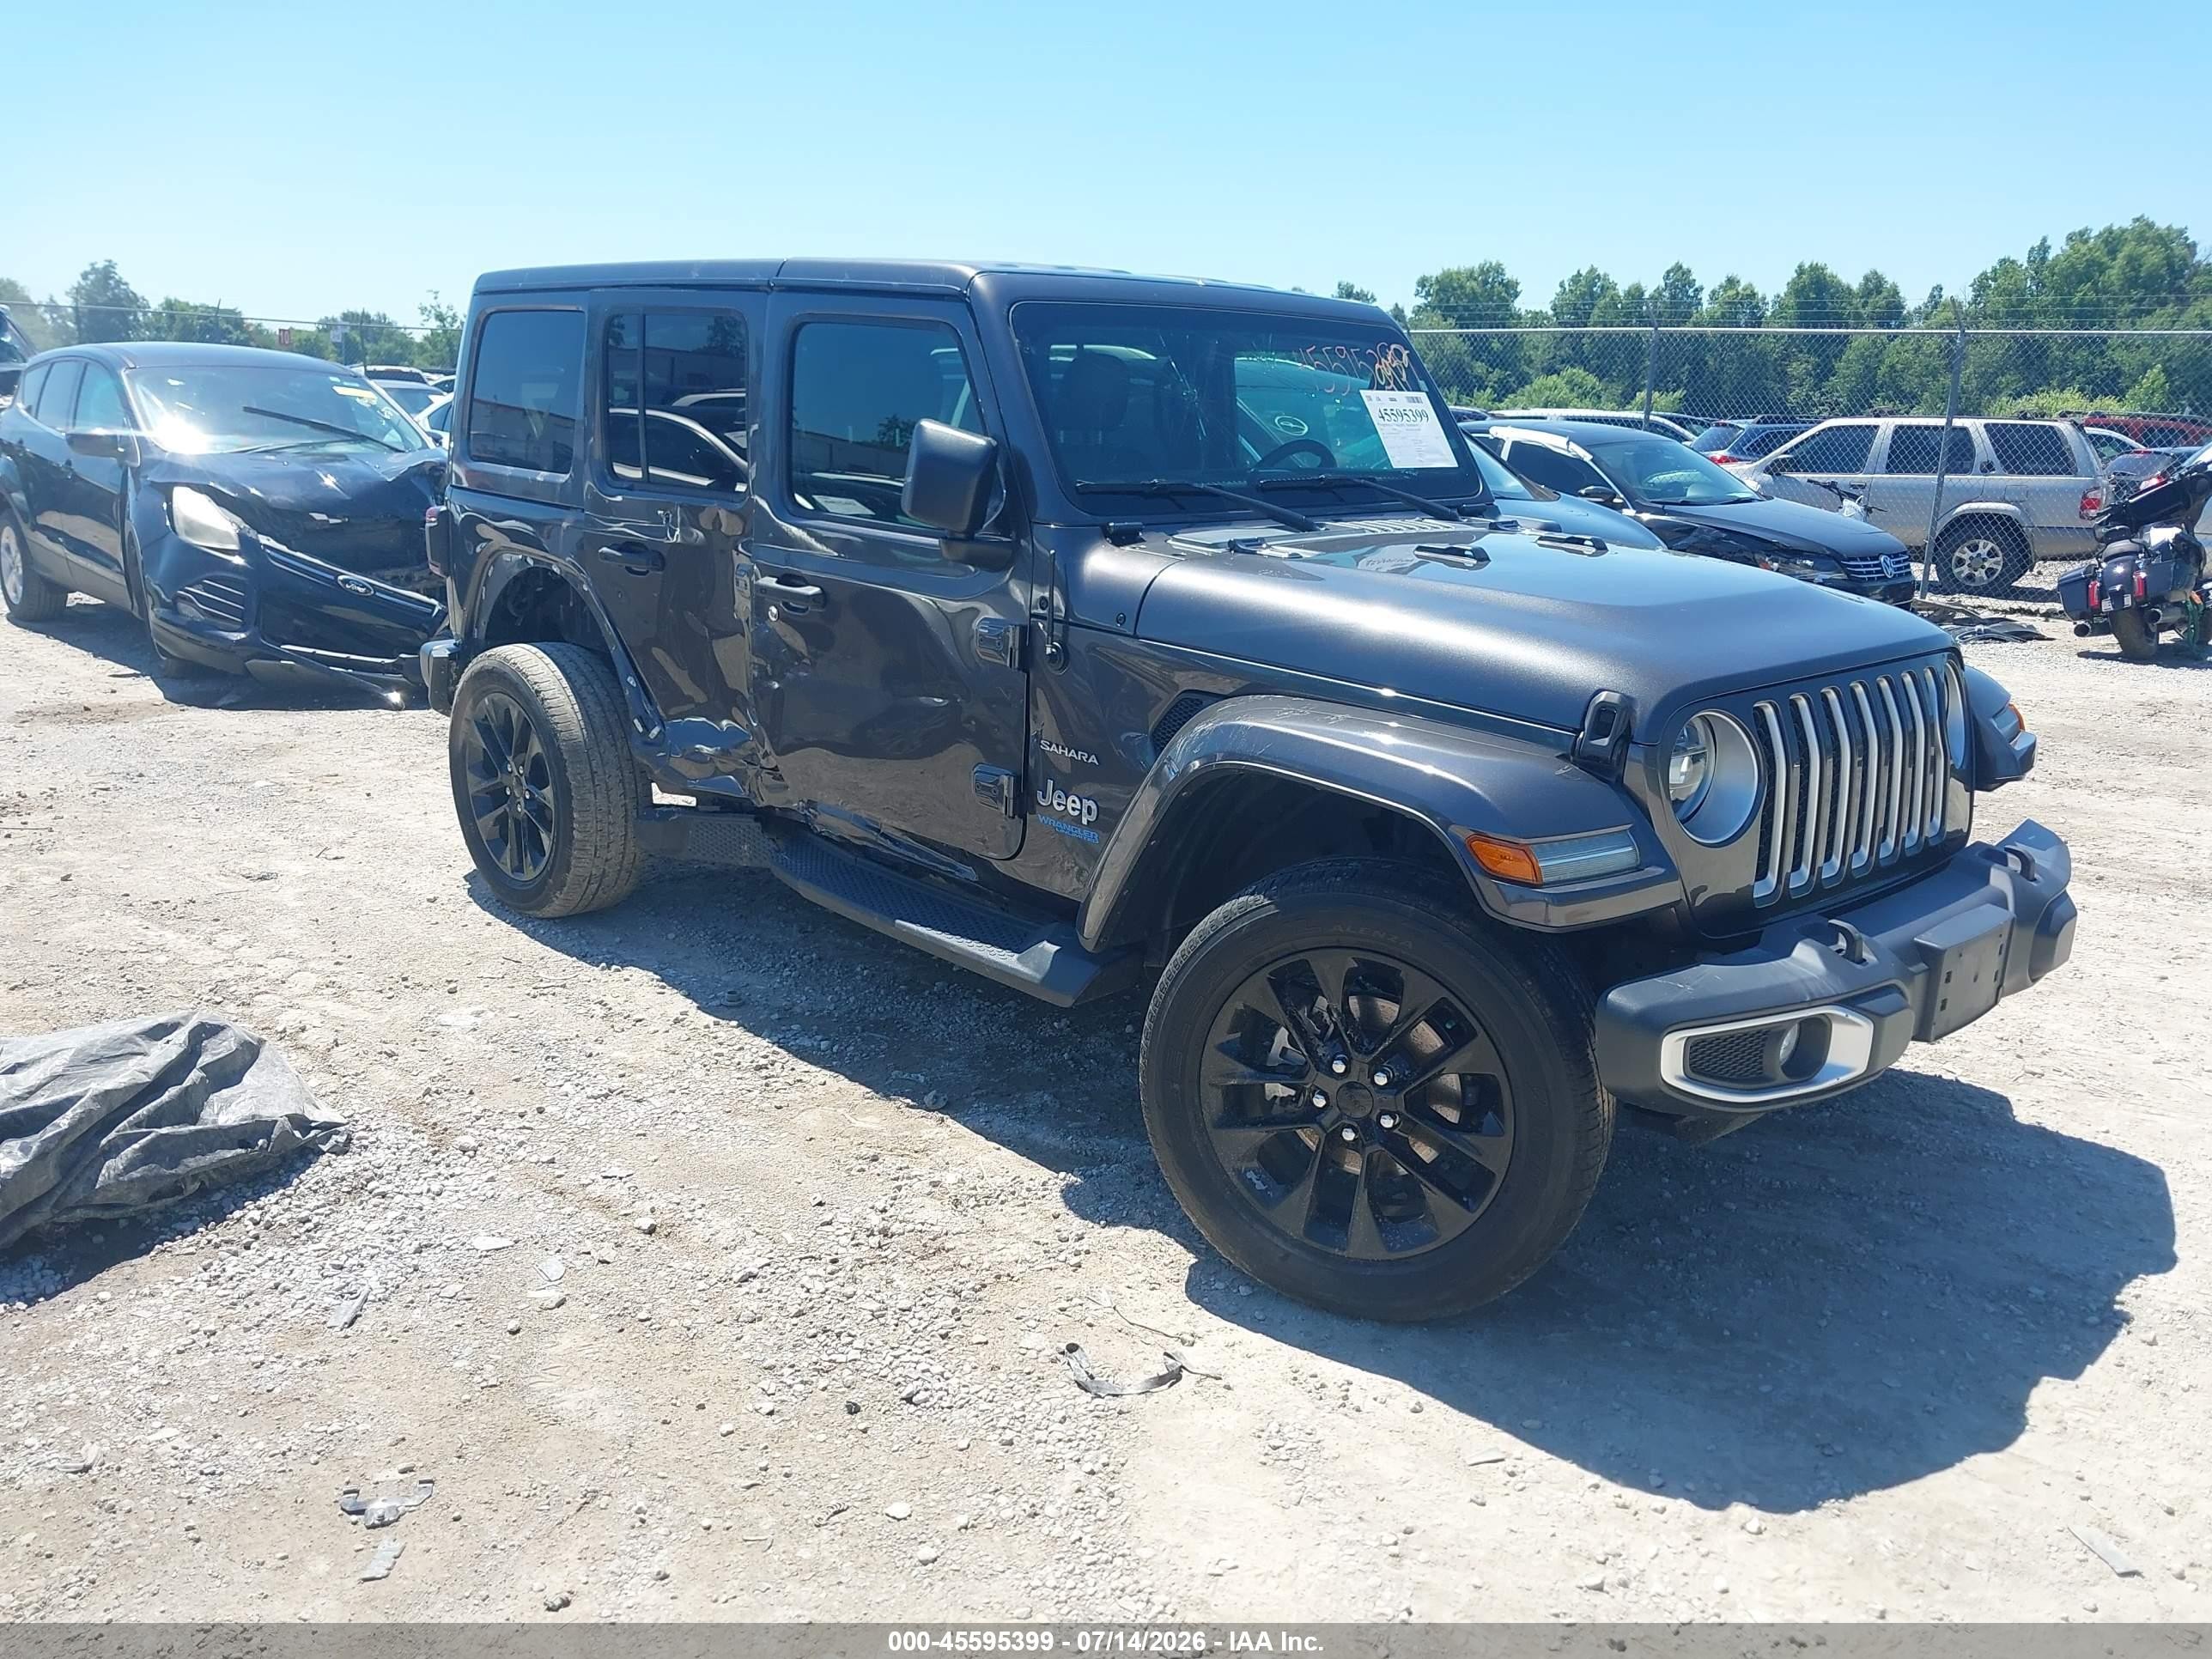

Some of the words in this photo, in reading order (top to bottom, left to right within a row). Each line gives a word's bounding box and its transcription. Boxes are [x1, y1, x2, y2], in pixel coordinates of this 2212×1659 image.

[1378, 407, 1430, 423] 45595399
[1040, 739, 1099, 765] SAHARA
[1036, 779, 1098, 825] Jeep
[1037, 814, 1099, 839] WRANGLER
